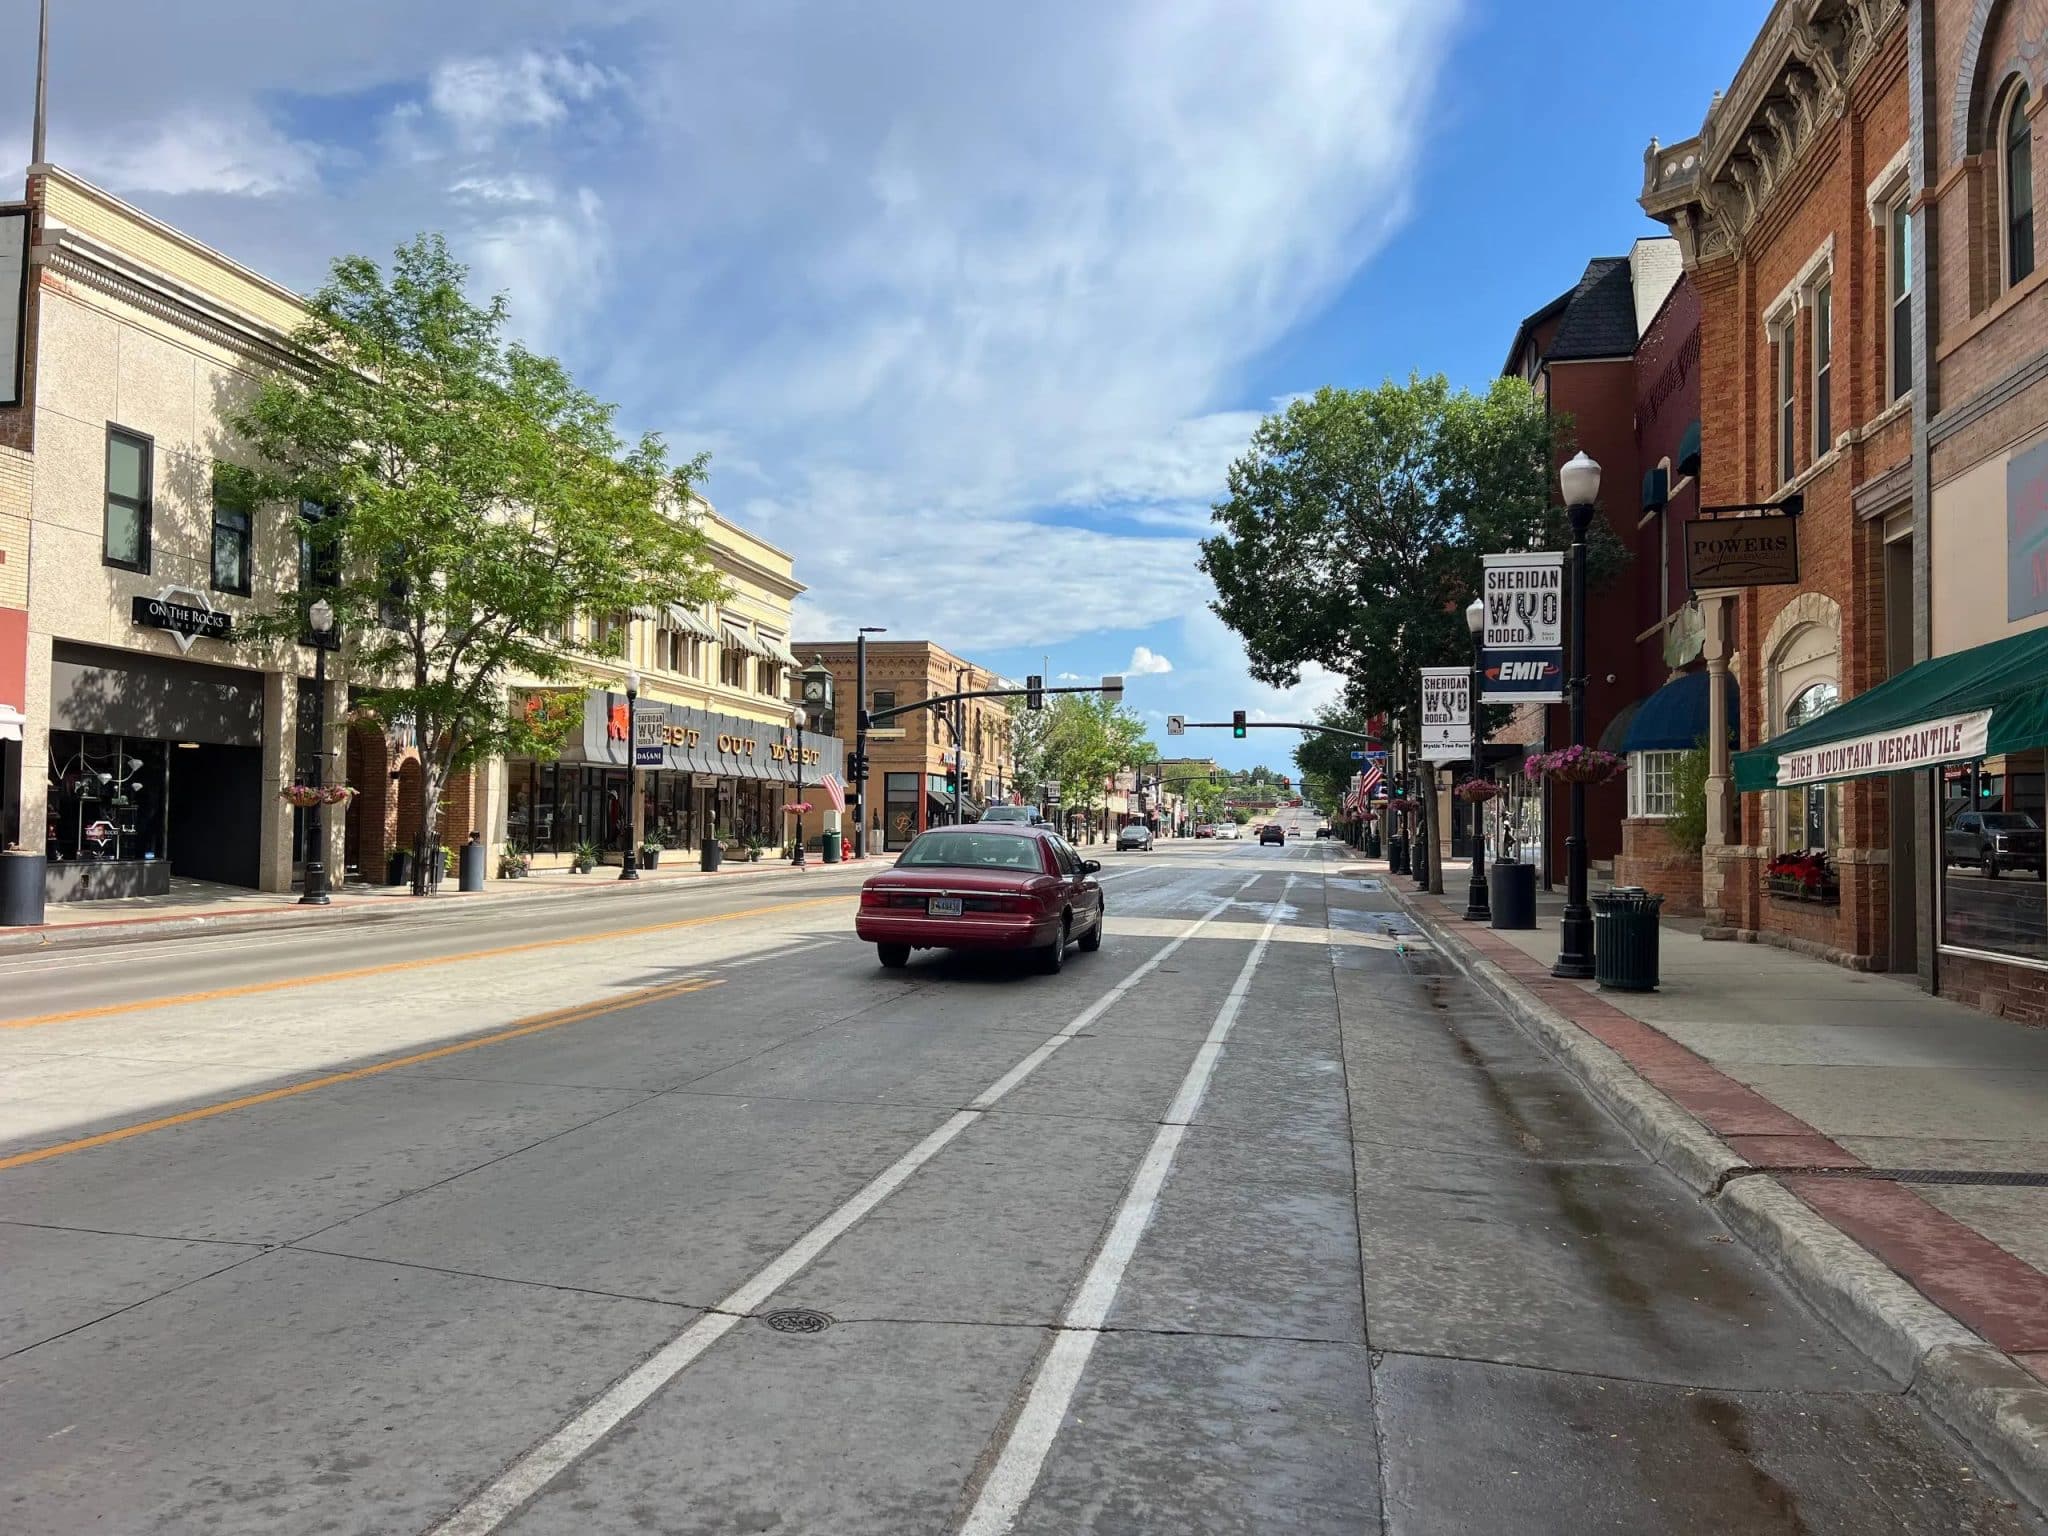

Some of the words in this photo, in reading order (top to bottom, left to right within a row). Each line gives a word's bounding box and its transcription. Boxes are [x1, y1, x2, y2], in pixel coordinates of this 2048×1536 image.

[1694, 536, 1788, 555] POWERS
[1488, 569, 1559, 589] SHERIDAN
[149, 602, 167, 617] ON
[169, 606, 189, 621] THE
[192, 610, 224, 627] ROCKS
[1489, 591, 1557, 641] WYO
[1488, 629, 1524, 643] RODEO
[1499, 662, 1548, 681] EMIT
[1424, 677, 1468, 690] SHERIDAN
[1424, 691, 1467, 721] WYO
[638, 715, 662, 723] SHERIDAN
[1424, 713, 1448, 723] RODEO
[638, 723, 662, 744] WYO
[637, 751, 661, 760] DASANI
[663, 725, 701, 749] EST
[718, 733, 757, 757] OUT
[770, 742, 821, 767] WEST
[1790, 755, 1813, 779] HIGH
[1817, 742, 1873, 774] MOUNTAIN
[1878, 724, 1963, 764] MERCANTILE
